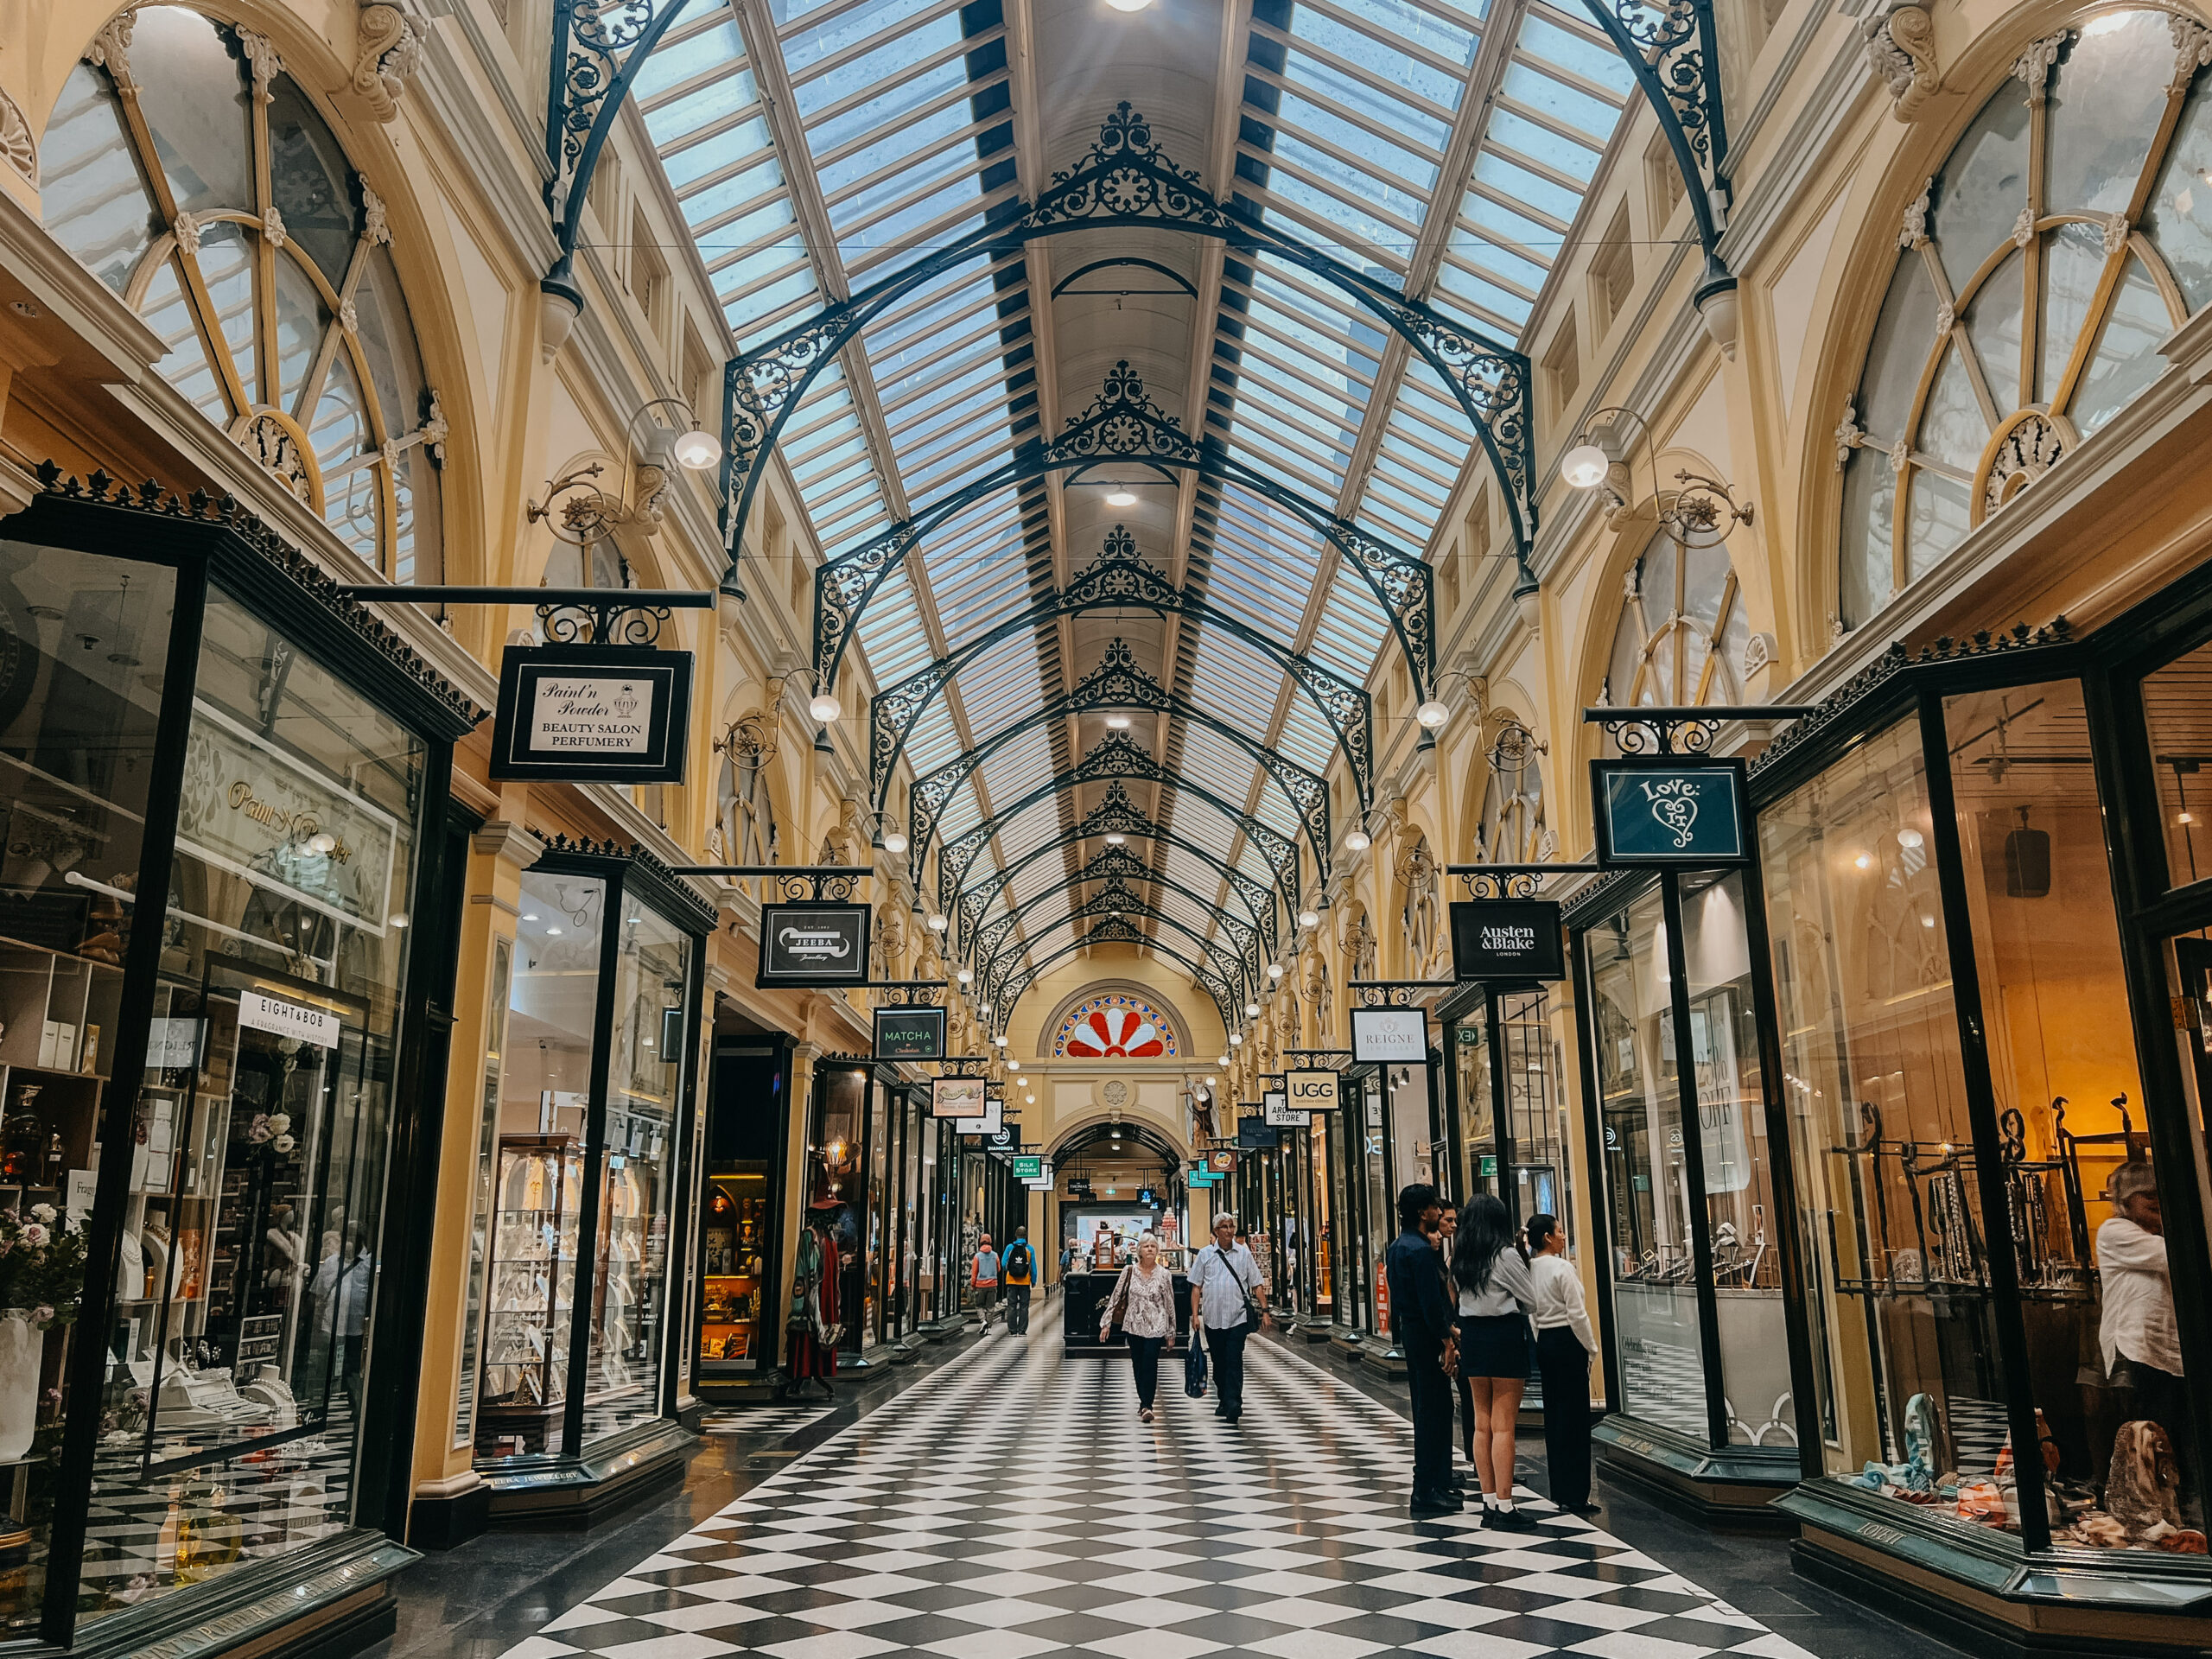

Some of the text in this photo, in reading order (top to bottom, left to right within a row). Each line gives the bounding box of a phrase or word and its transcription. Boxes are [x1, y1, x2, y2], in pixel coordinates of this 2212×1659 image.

[557, 699, 609, 716] Powder
[543, 722, 642, 734] BEAUTY SALON
[552, 736, 633, 747] PERFUMERY
[1667, 812, 1687, 827] IT
[1479, 925, 1535, 938] Austen
[1482, 938, 1535, 950] &Blake
[261, 1000, 323, 1027] EIGHT&BOB
[256, 1019, 290, 1035] FRAGRANCE
[291, 1029, 305, 1038] WITH
[885, 1031, 931, 1041] MATCHA
[1366, 1034, 1414, 1044] REIGNE
[1293, 1083, 1333, 1097] UGG
[1699, 1086, 1732, 1130] OFF
[524, 1471, 578, 1483] JEWELLERY
